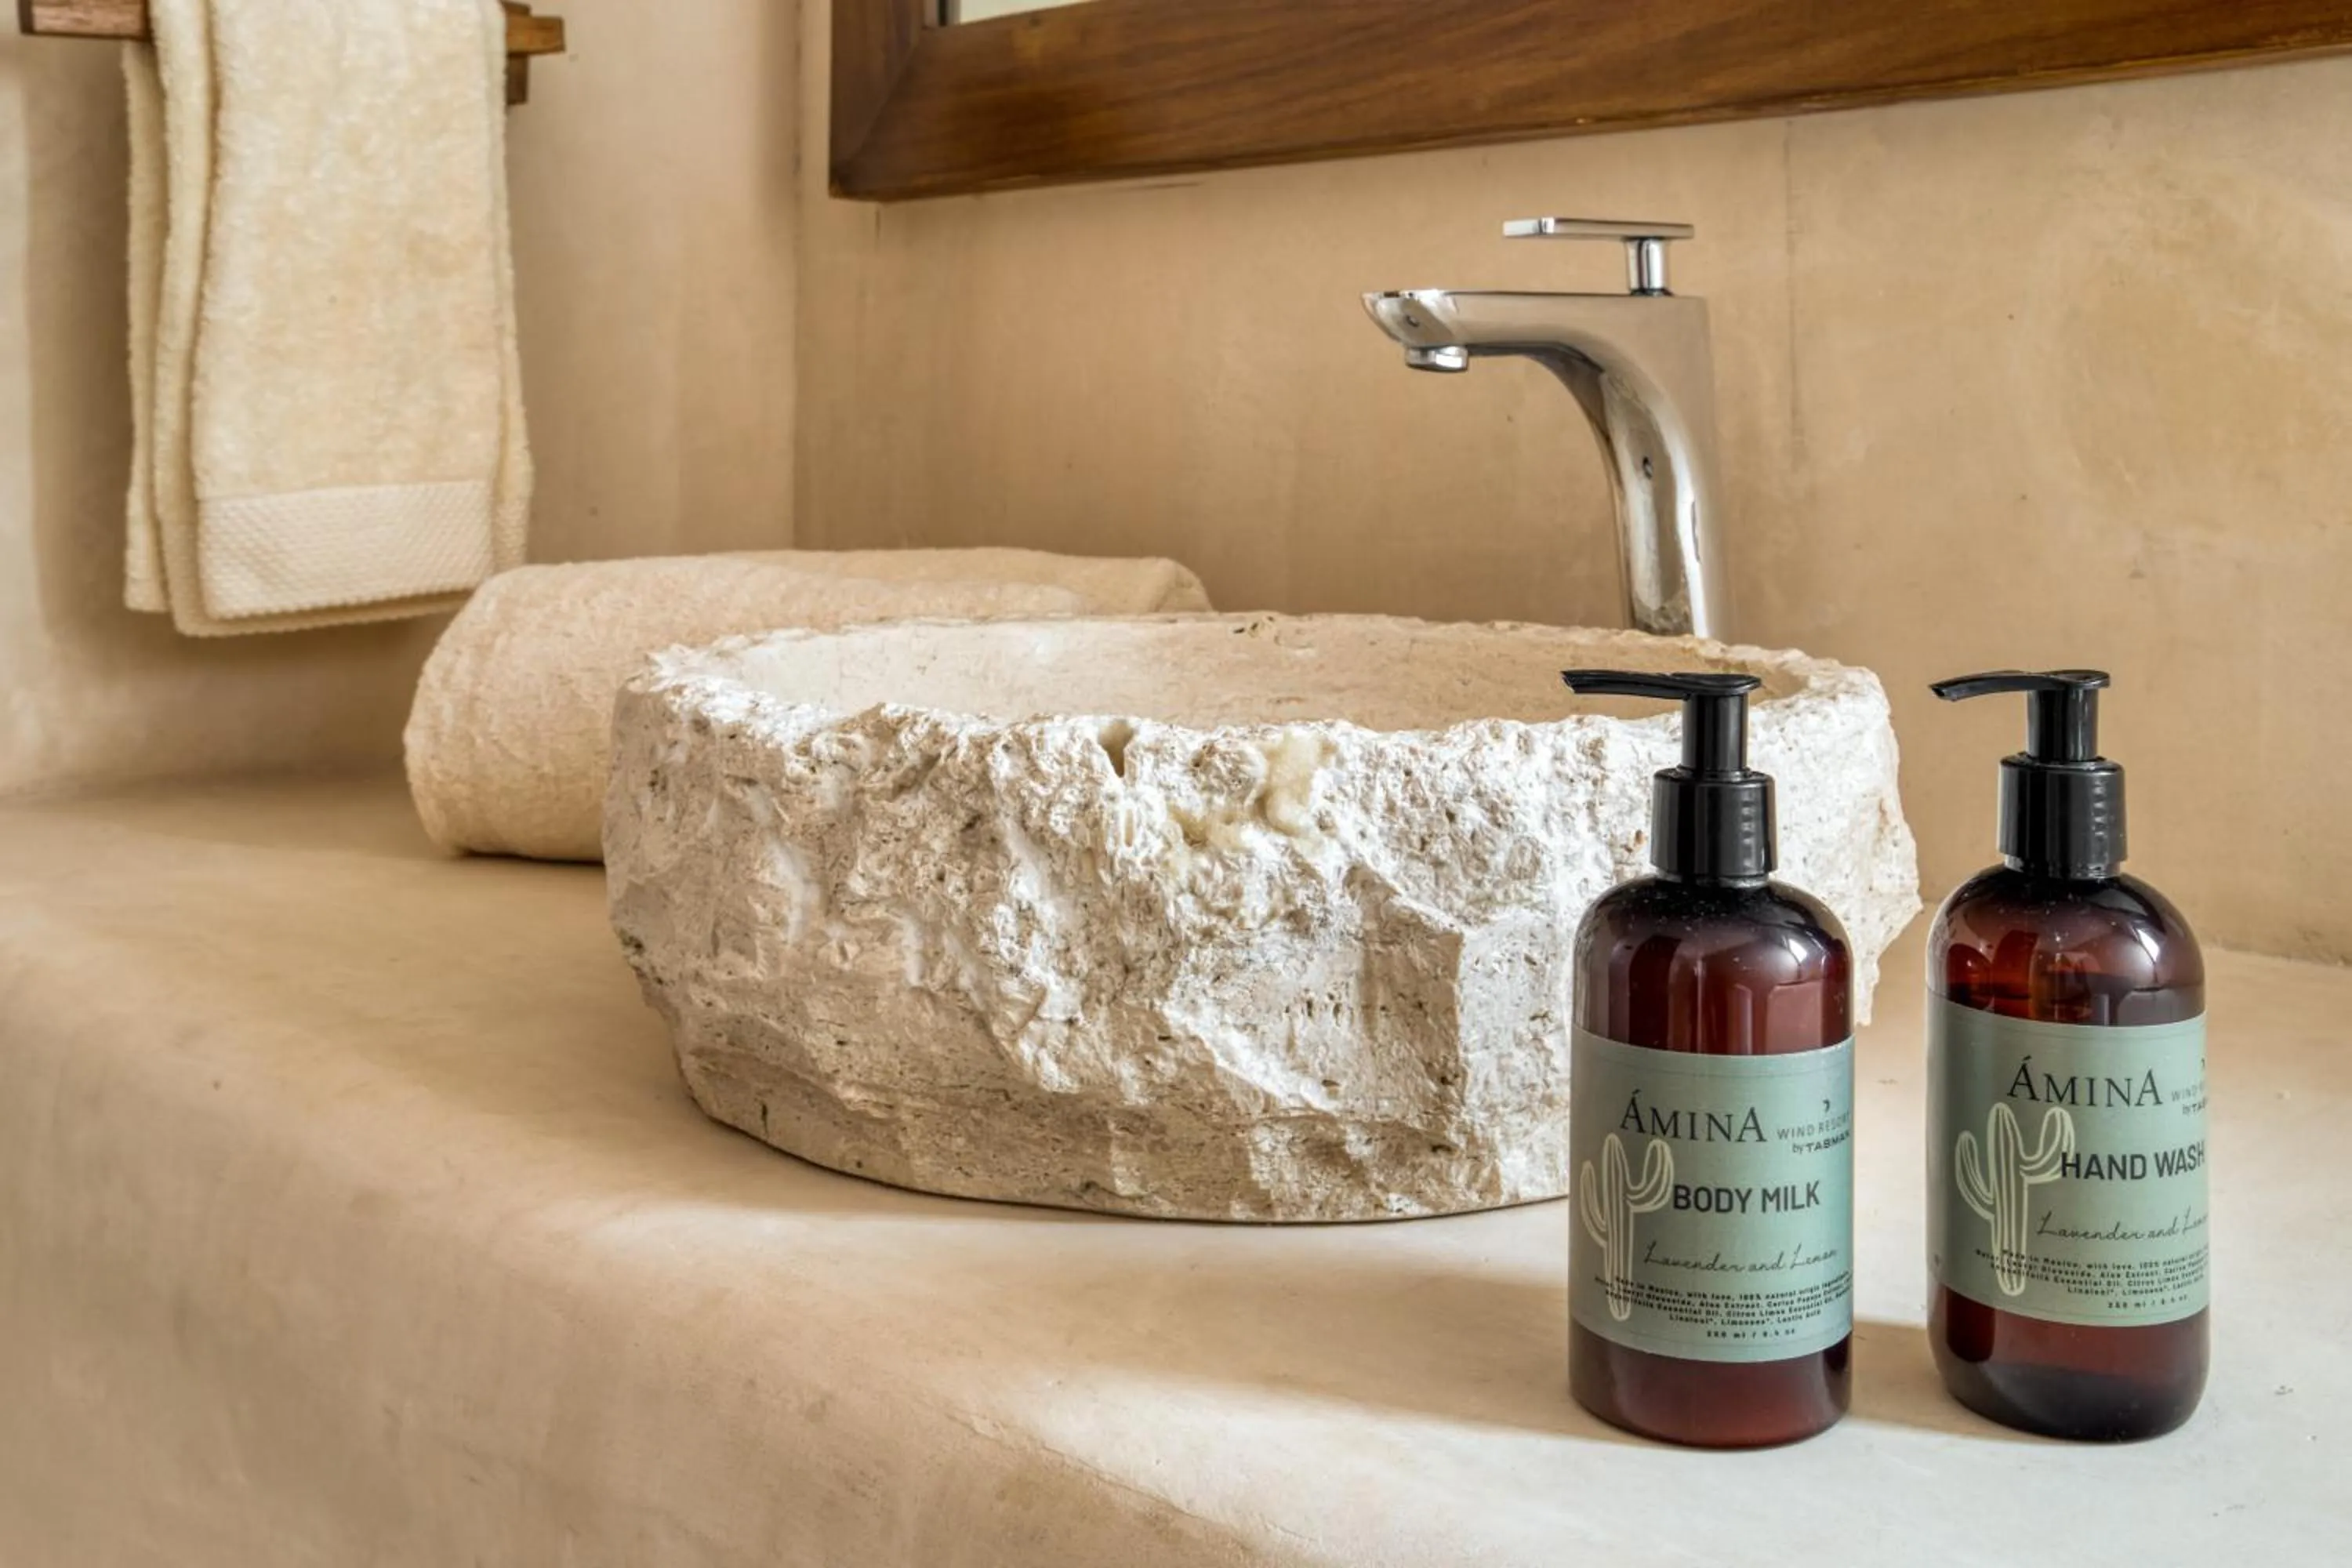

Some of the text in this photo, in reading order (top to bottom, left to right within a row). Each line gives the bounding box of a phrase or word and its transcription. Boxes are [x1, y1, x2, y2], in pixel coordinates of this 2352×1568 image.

[2007, 1055, 2164, 1108] ÁMINA
[1620, 1088, 1768, 1142] ÁMINA
[1777, 1123, 1815, 1140] WIND
[1792, 1142, 1804, 1156] by
[2061, 1141, 2206, 1181] HAND WASH
[1673, 1179, 1820, 1214] BODY MILK
[2037, 1210, 2145, 1241] Lavender
[2147, 1216, 2180, 1239] and
[1643, 1240, 1838, 1272] Lavender and Lemon
